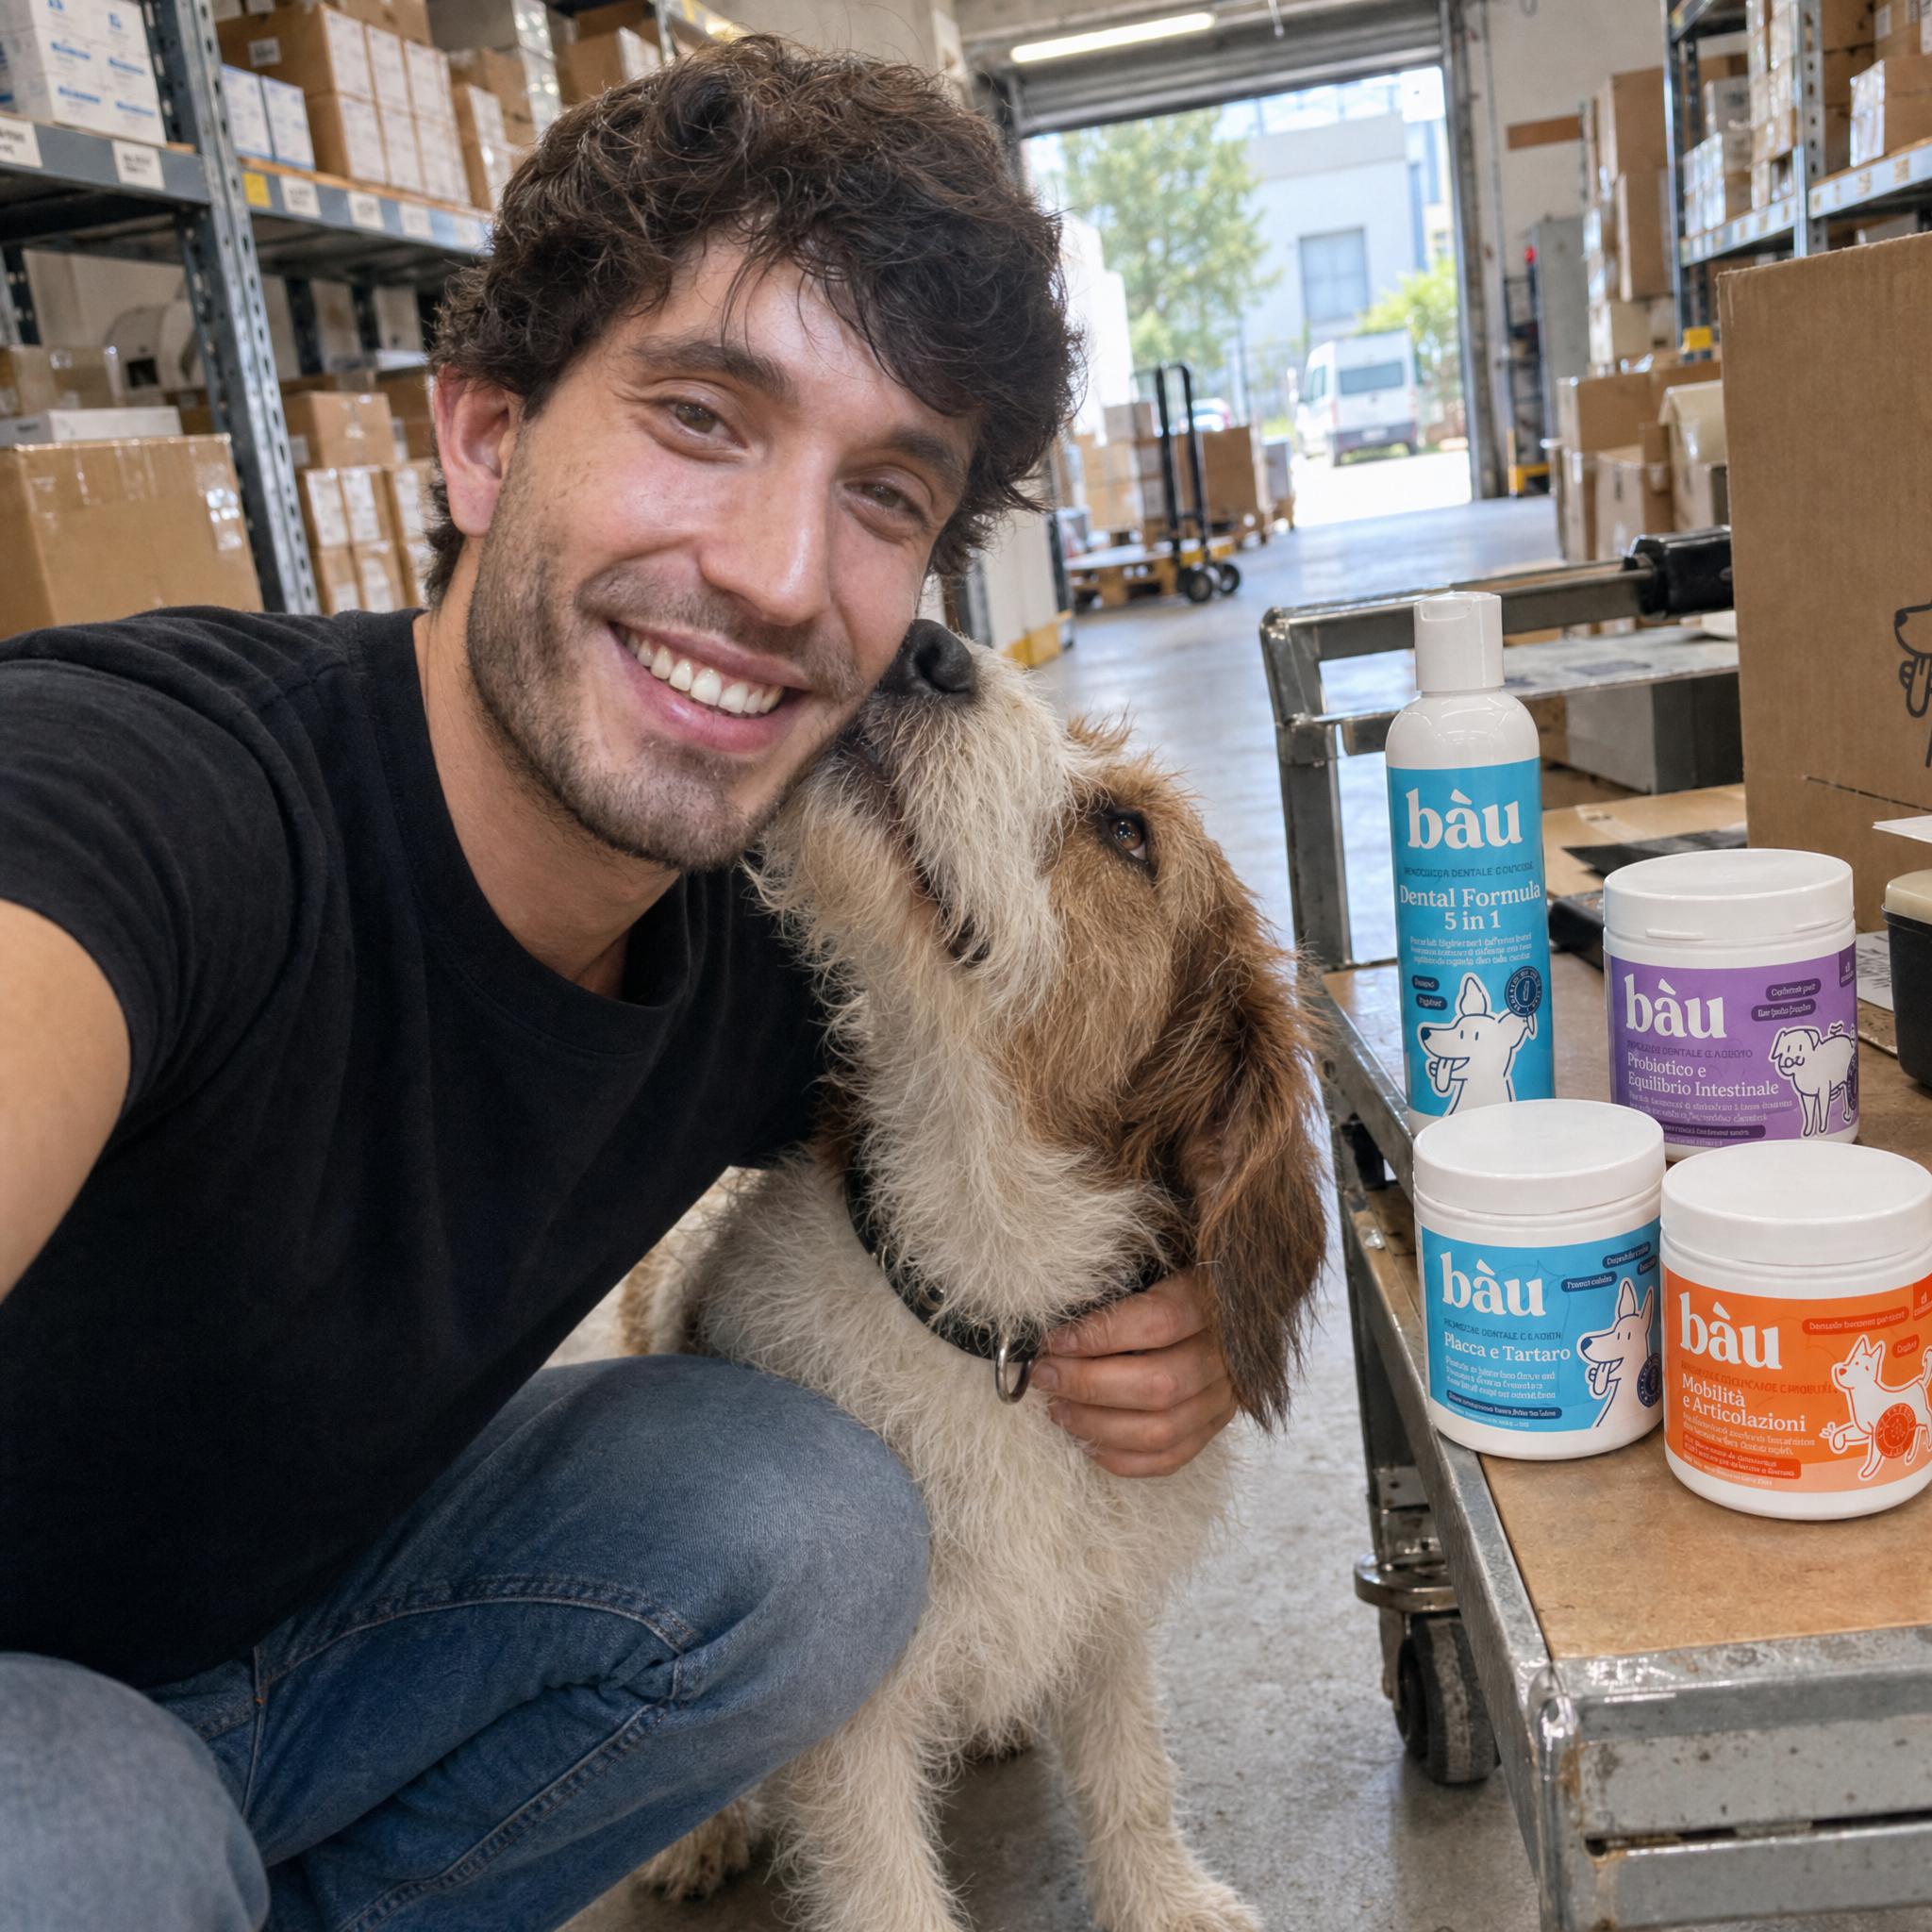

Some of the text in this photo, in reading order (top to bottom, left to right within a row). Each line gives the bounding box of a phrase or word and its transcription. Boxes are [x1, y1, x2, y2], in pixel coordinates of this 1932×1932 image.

[1406, 788, 1523, 849] bàu
[1399, 880, 1541, 908] Dental Formula
[1444, 910, 1501, 930] 5 in 1
[1624, 974, 1727, 1039] bàu
[1627, 1052, 1692, 1076] Probiotico
[1698, 1066, 1707, 1077] e
[1628, 1070, 1779, 1098] Equilibrio Intestinale
[1441, 1252, 1547, 1317] bàu
[1444, 1331, 1571, 1362] Placca e Tartaro
[1679, 1291, 1782, 1370] bàu
[1682, 1374, 1746, 1408] Mobilità
[1683, 1394, 1690, 1407] e
[1692, 1397, 1807, 1433] Articolazioni
